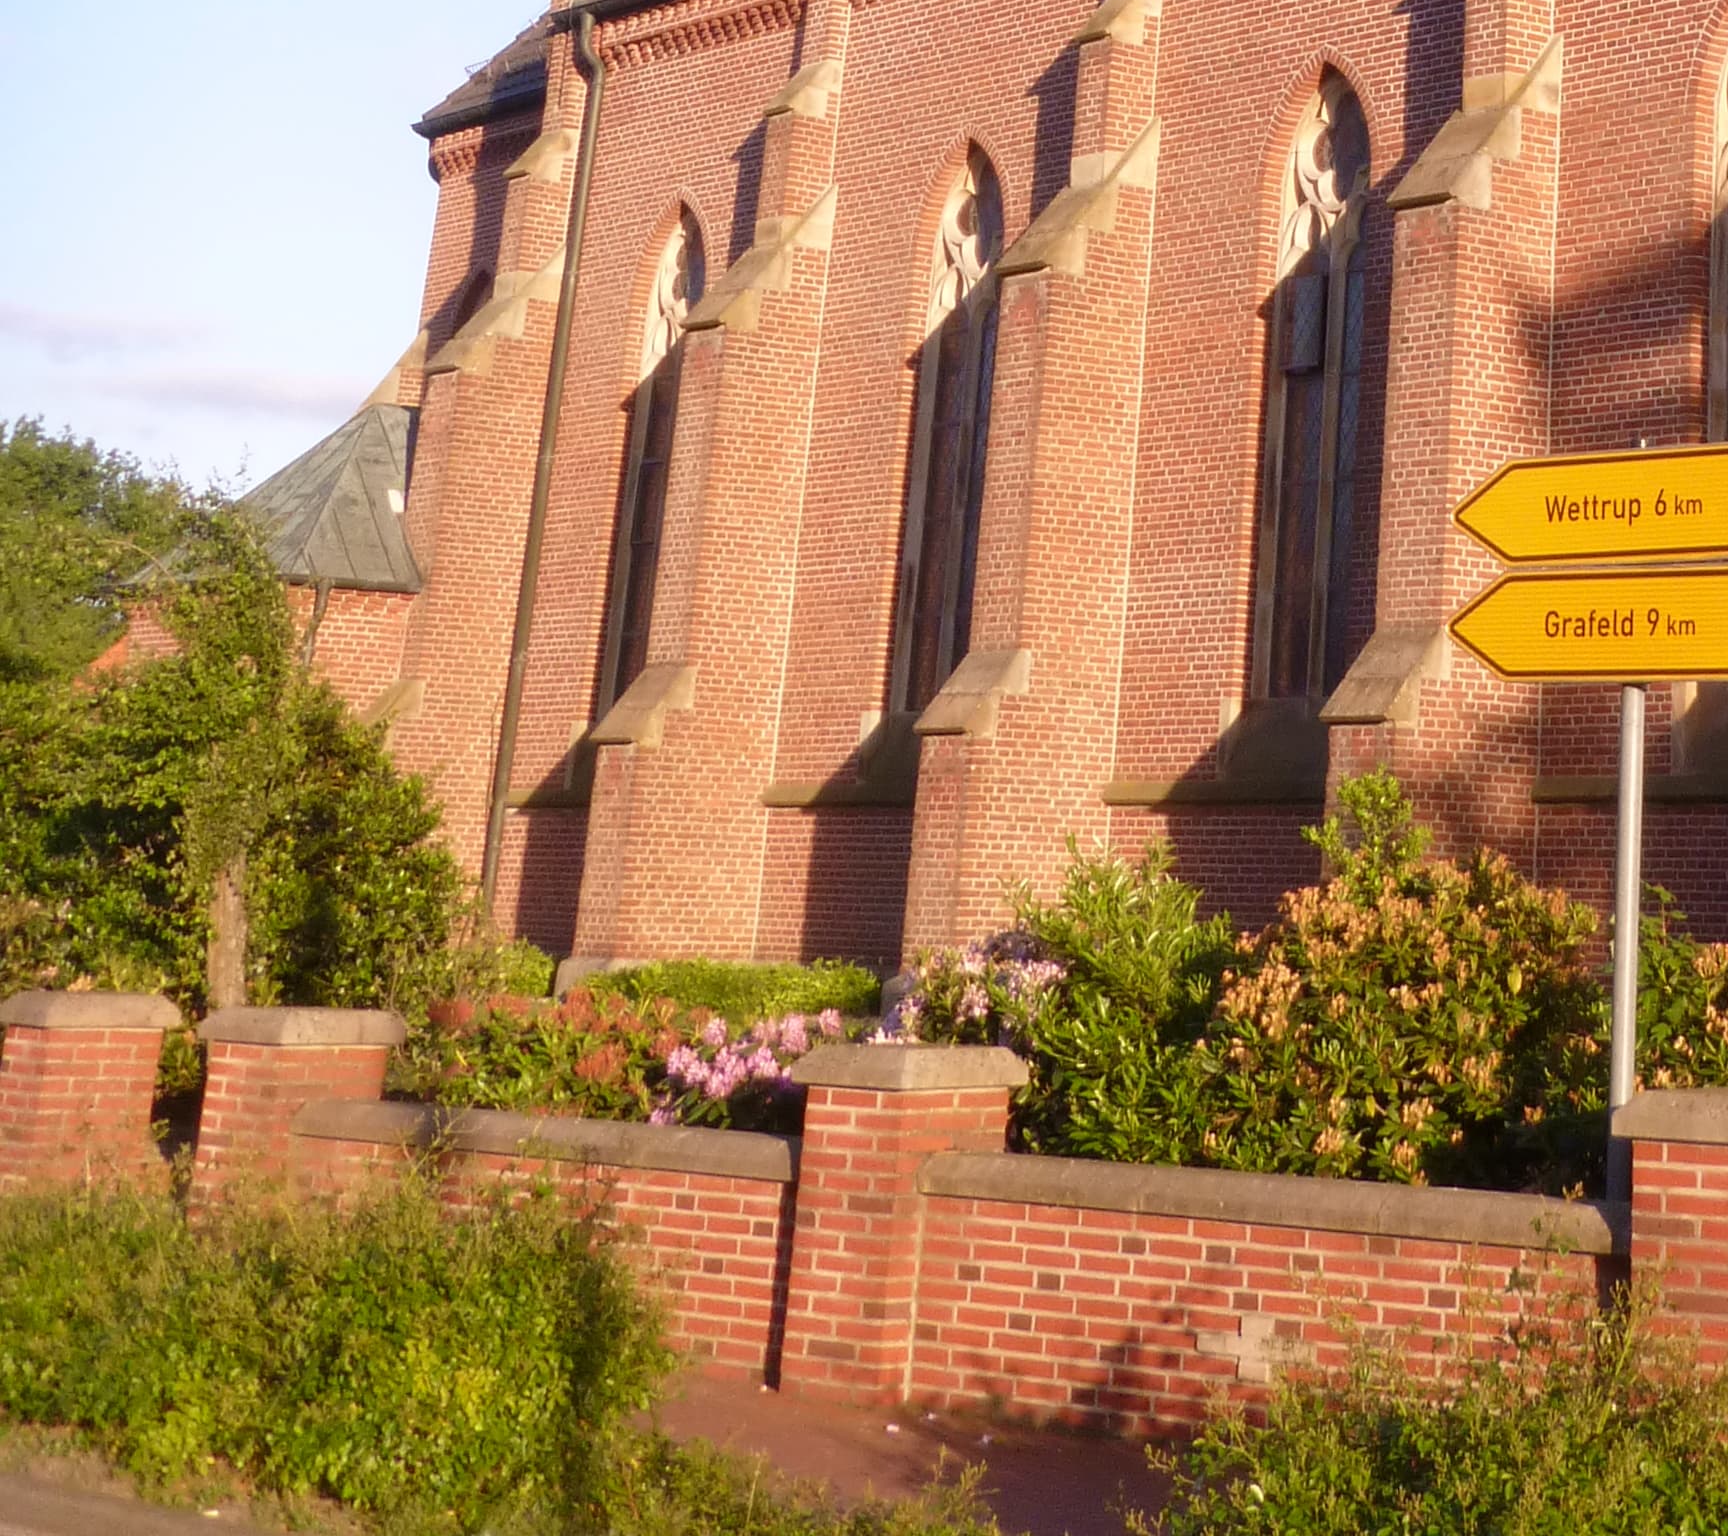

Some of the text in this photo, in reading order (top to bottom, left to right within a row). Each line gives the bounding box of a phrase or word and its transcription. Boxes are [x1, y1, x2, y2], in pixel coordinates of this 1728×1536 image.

[1545, 488, 1703, 526] Wettrup 6 km
[1545, 608, 1696, 638] Grafeld 9 km
